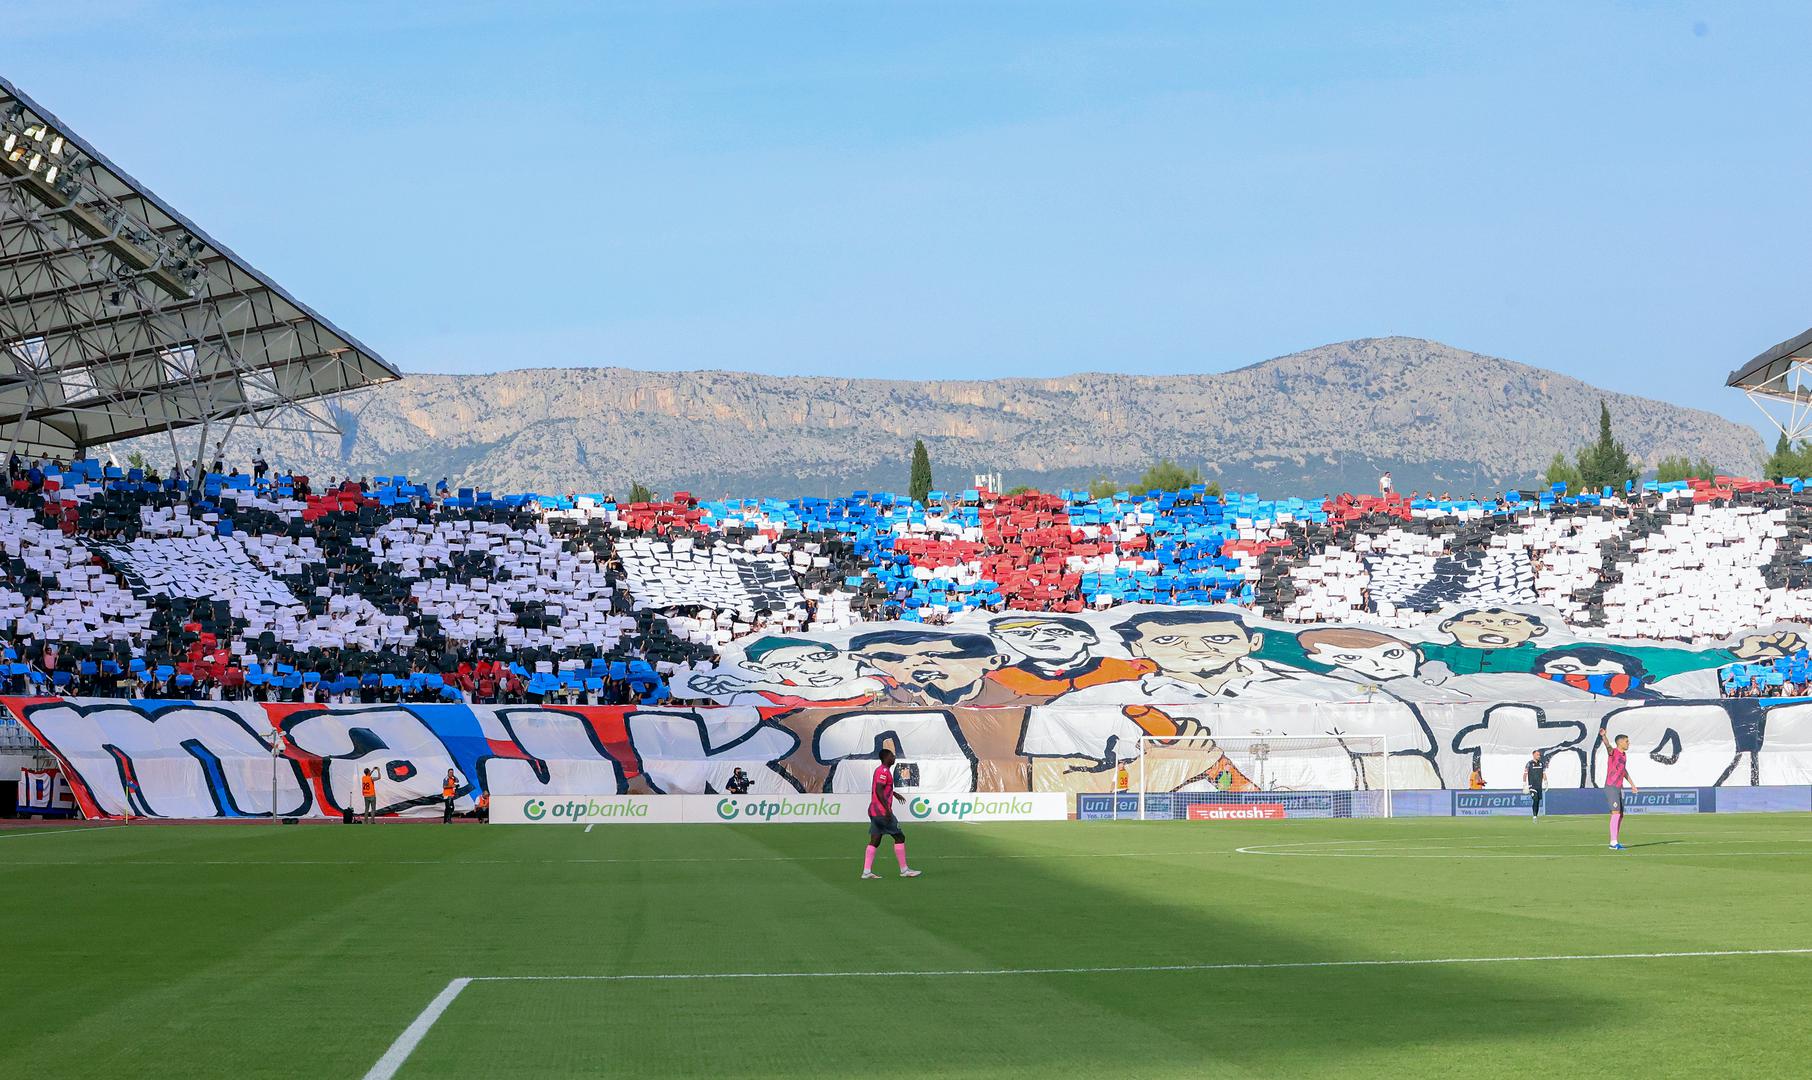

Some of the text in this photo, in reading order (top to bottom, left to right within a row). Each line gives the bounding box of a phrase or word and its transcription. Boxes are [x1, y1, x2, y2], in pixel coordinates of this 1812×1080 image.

[1085, 798, 1110, 811] uni
[1460, 795, 1483, 807] uni
[1487, 795, 1517, 807] rent
[1622, 793, 1639, 805] ni
[1641, 793, 1671, 804] rent
[552, 799, 649, 822] otpbanka
[745, 798, 841, 821] otpbanka
[937, 796, 1033, 819] otpbanka
[1209, 806, 1264, 819] aircash
